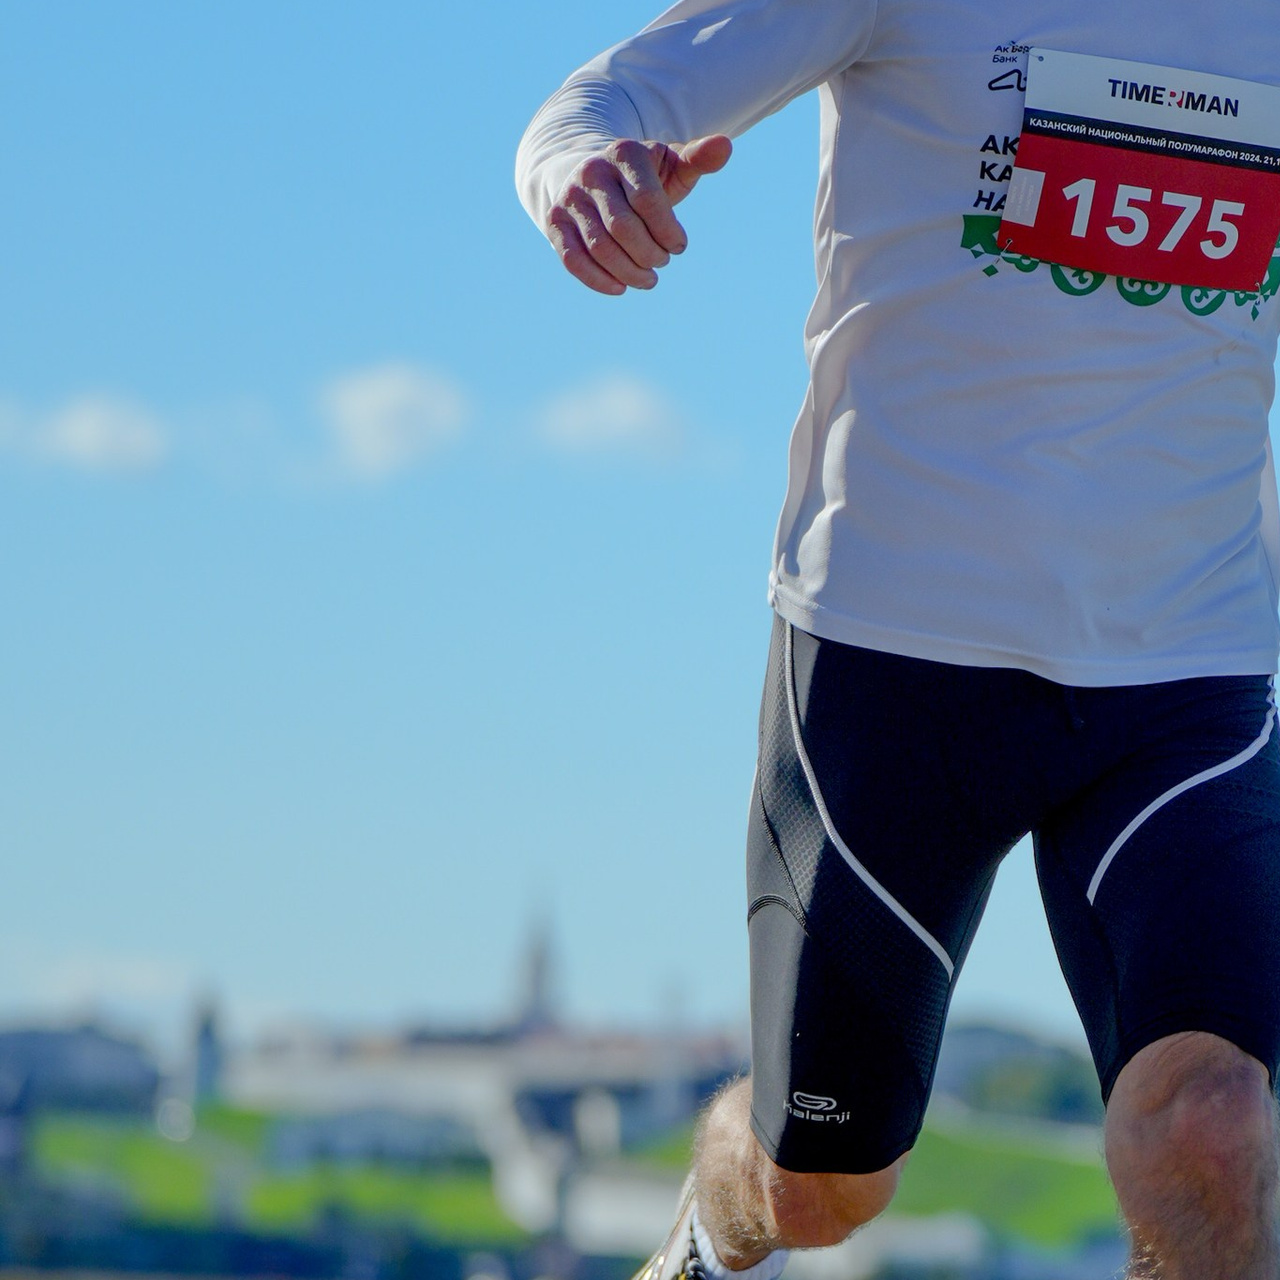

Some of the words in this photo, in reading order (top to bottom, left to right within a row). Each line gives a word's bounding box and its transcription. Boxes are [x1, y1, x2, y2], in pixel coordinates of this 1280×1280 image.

[992, 55, 1018, 63] Банк
[994, 45, 1009, 53] Ак
[1029, 117, 1087, 135] КАЗАНСКИЙ
[1088, 126, 1166, 148] НАЦИОНАЛЬНЫЙ
[1167, 139, 1239, 160] ПОЛУМАРАФОН
[1239, 151, 1262, 165] 2024.
[1264, 155, 1280, 167] 21,1
[1061, 178, 1246, 260] 1575
[782, 1099, 851, 1124] kalenji
